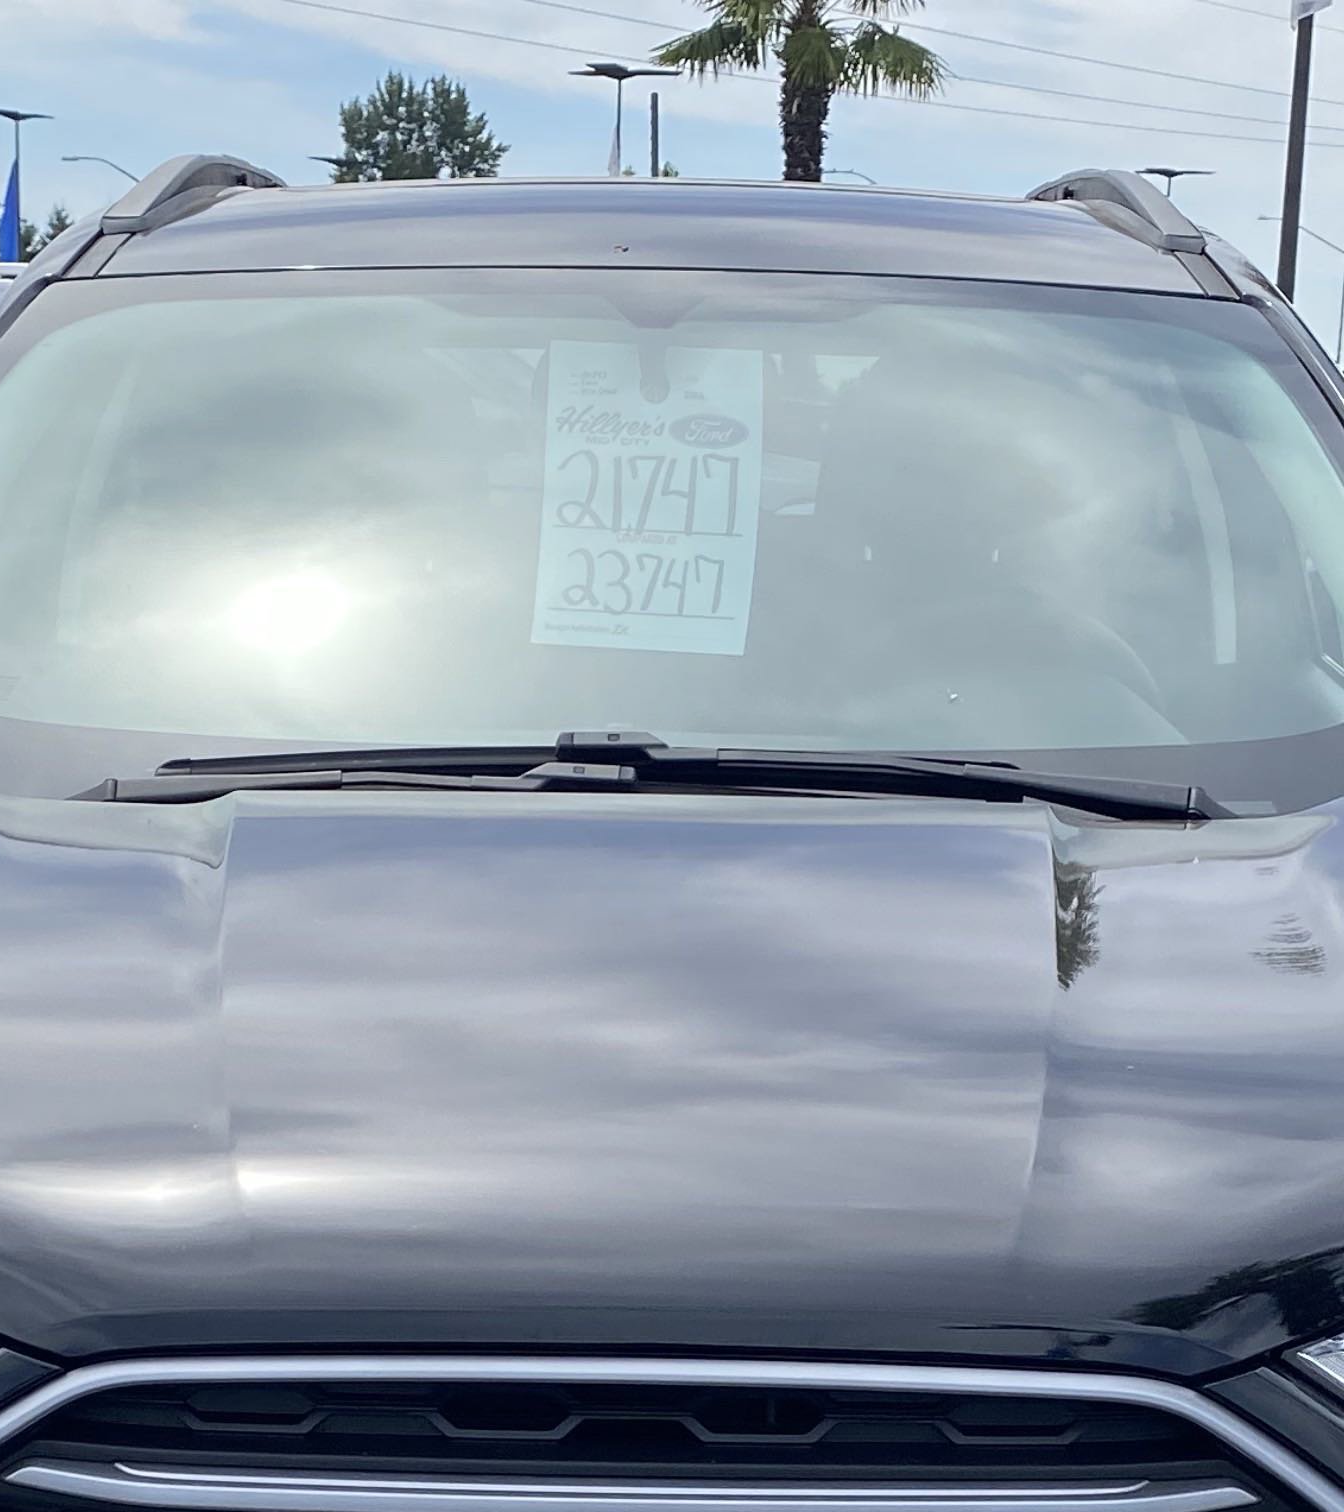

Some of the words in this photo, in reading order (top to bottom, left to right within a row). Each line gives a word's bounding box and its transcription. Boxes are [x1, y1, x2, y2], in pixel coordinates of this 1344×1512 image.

[555, 404, 666, 440] Hillyer's
[684, 419, 734, 442] Ford
[619, 437, 651, 446] CITY
[560, 547, 725, 616] 23747
